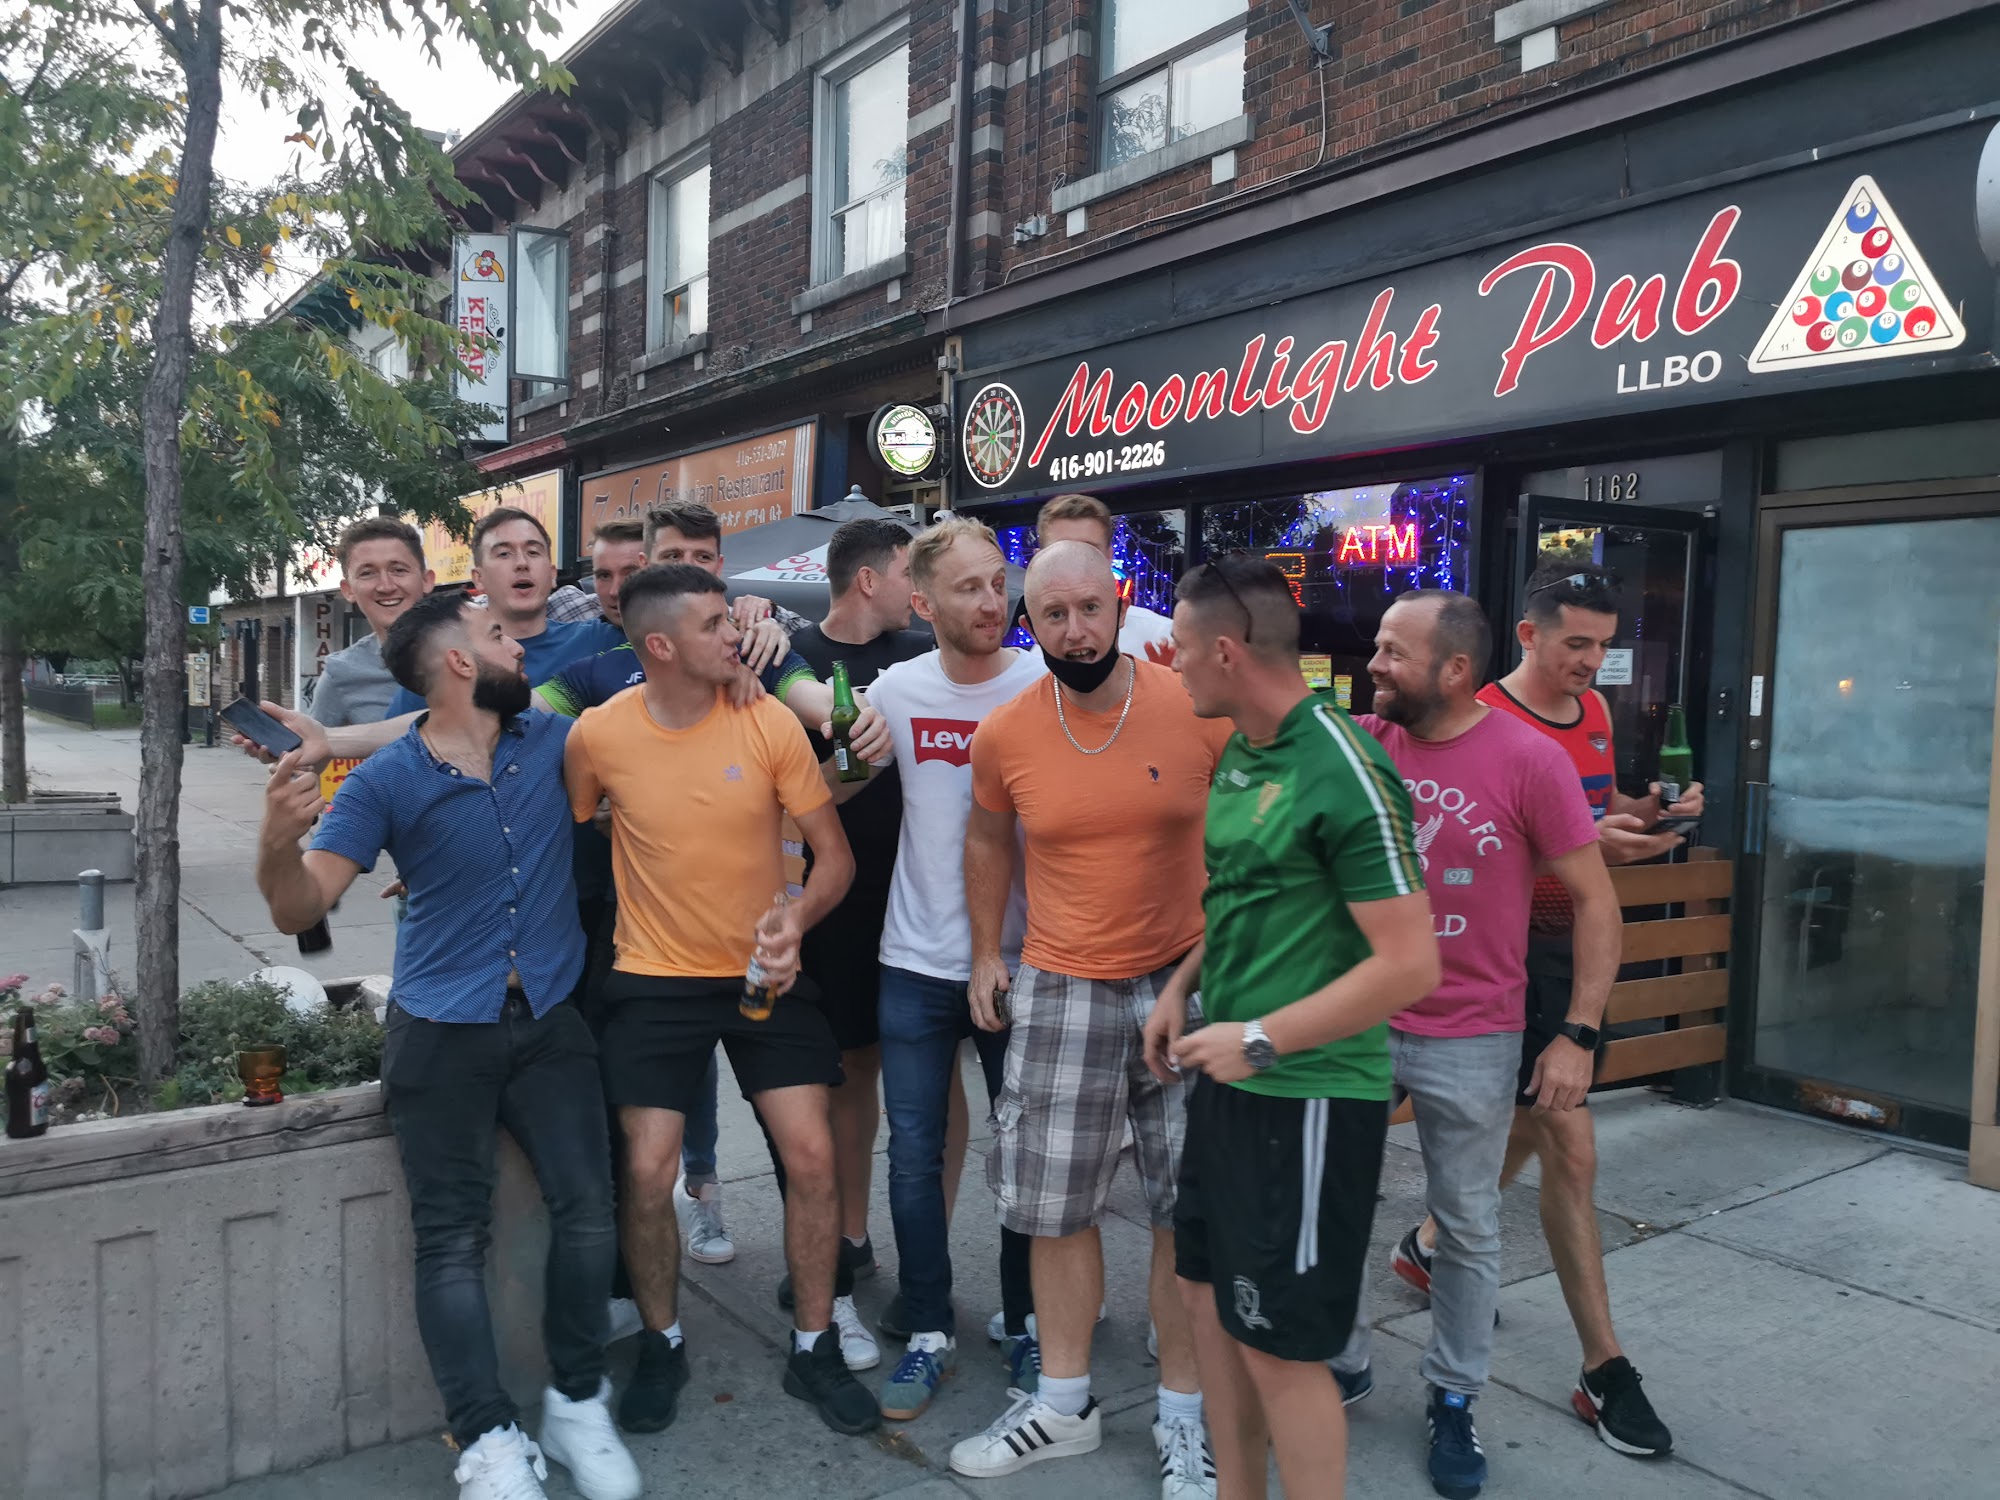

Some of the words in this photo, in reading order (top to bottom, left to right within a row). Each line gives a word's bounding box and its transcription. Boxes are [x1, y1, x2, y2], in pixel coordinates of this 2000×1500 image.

[458, 316, 468, 362] HOSE
[1028, 286, 1441, 468] Moonlight
[1478, 205, 1742, 398] Pub
[1617, 350, 1722, 394] LLBO
[1049, 440, 1165, 481] 416-901-2226
[717, 464, 785, 502] Restaurant
[1584, 472, 1638, 502] 1162
[1340, 523, 1417, 561] ATM
[920, 730, 973, 750] Lev
[1402, 779, 1478, 825] POOL
[1468, 820, 1503, 856] FC
[1449, 870, 1470, 883] 92
